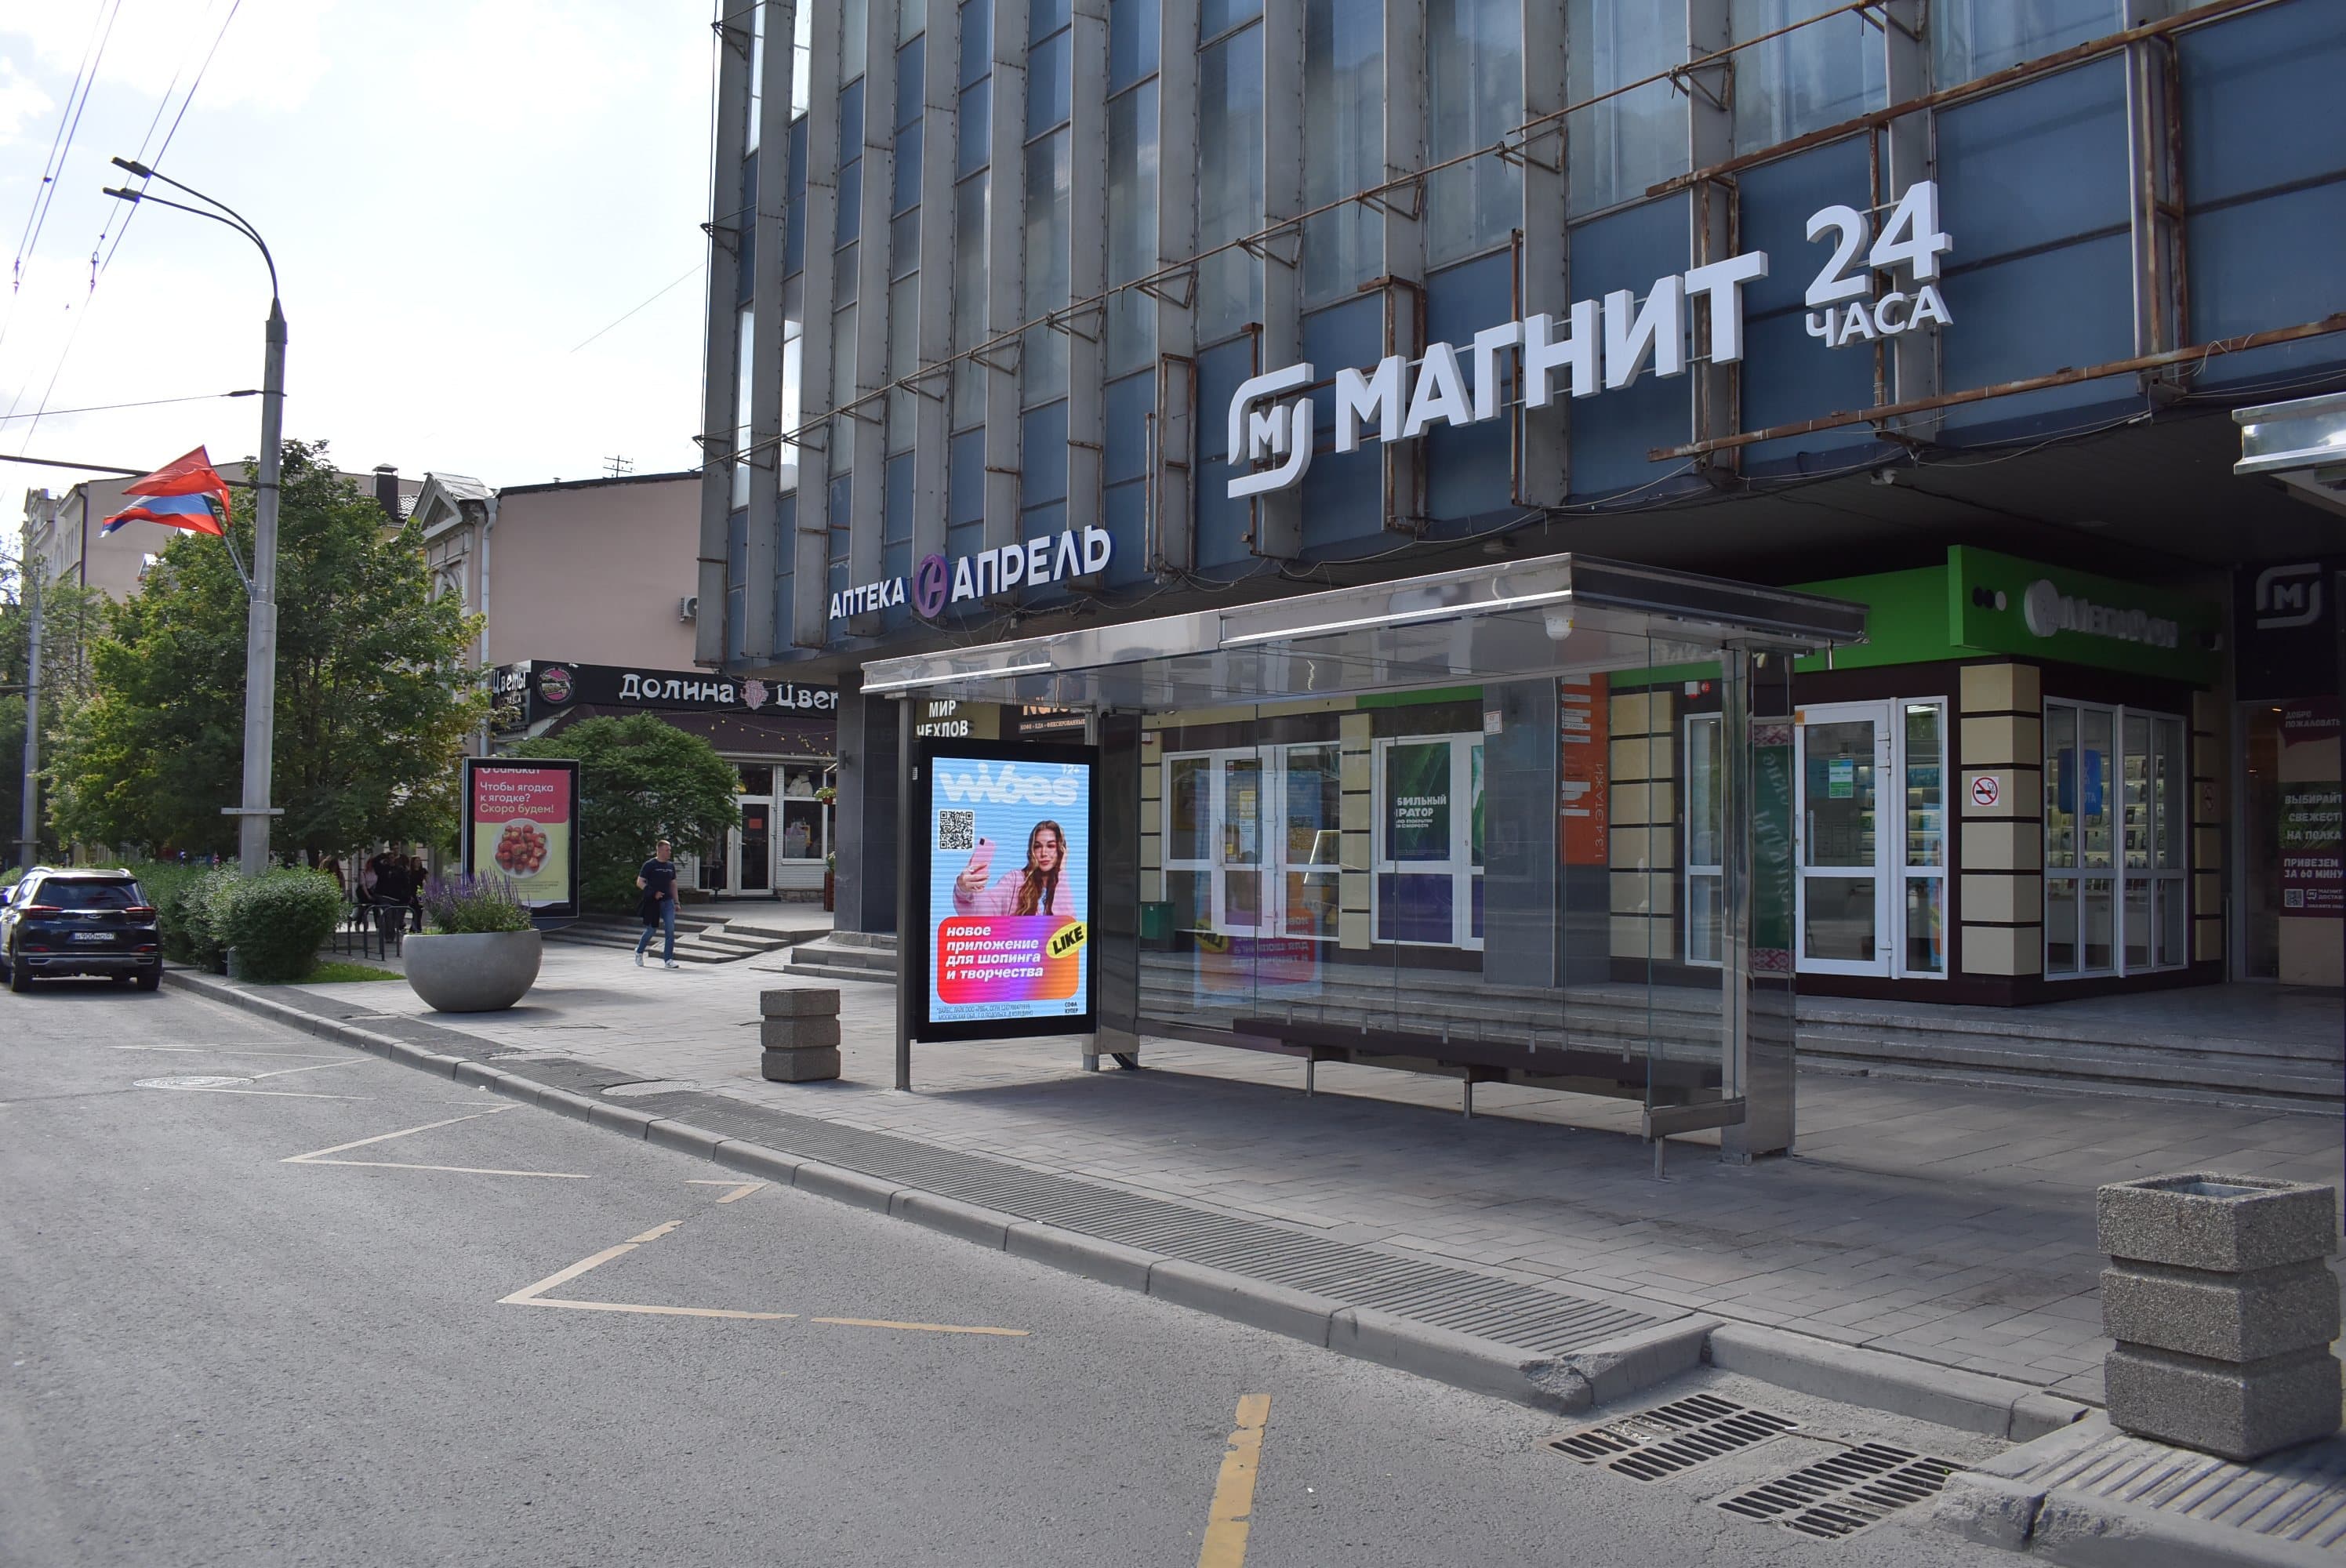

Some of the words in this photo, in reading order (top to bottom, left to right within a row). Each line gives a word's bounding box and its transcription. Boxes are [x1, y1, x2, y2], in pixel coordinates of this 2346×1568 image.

[1805, 180, 1952, 309] 24
[1805, 285, 1953, 349] ЧАСА
[1335, 249, 1768, 454] МАГНИТ
[829, 576, 906, 620] АПТЕКА
[951, 525, 1113, 609] АПРЕЛЬ
[619, 673, 734, 703] Долина
[928, 700, 957, 718] МИР
[917, 720, 969, 738] ЧЕХЛОВ
[480, 782, 514, 792] Чтобы
[518, 784, 554, 794] ягодка
[1593, 763, 1605, 822] ЭТАЖИ
[489, 793, 531, 804] ягодке?
[480, 804, 515, 815] Скоро
[518, 804, 554, 815] будем!
[2286, 830, 2302, 840] НА
[2283, 858, 2339, 867] ПРИВЕЗЕМ
[2284, 869, 2297, 878] ЗА
[2300, 869, 2312, 878] 60
[946, 926, 992, 937] новое
[946, 939, 1040, 955] приложение
[1052, 925, 1084, 955] LIKE
[945, 954, 974, 967] для
[977, 953, 1042, 965] шопинга
[946, 969, 956, 980] и
[960, 966, 1044, 982] творчества
